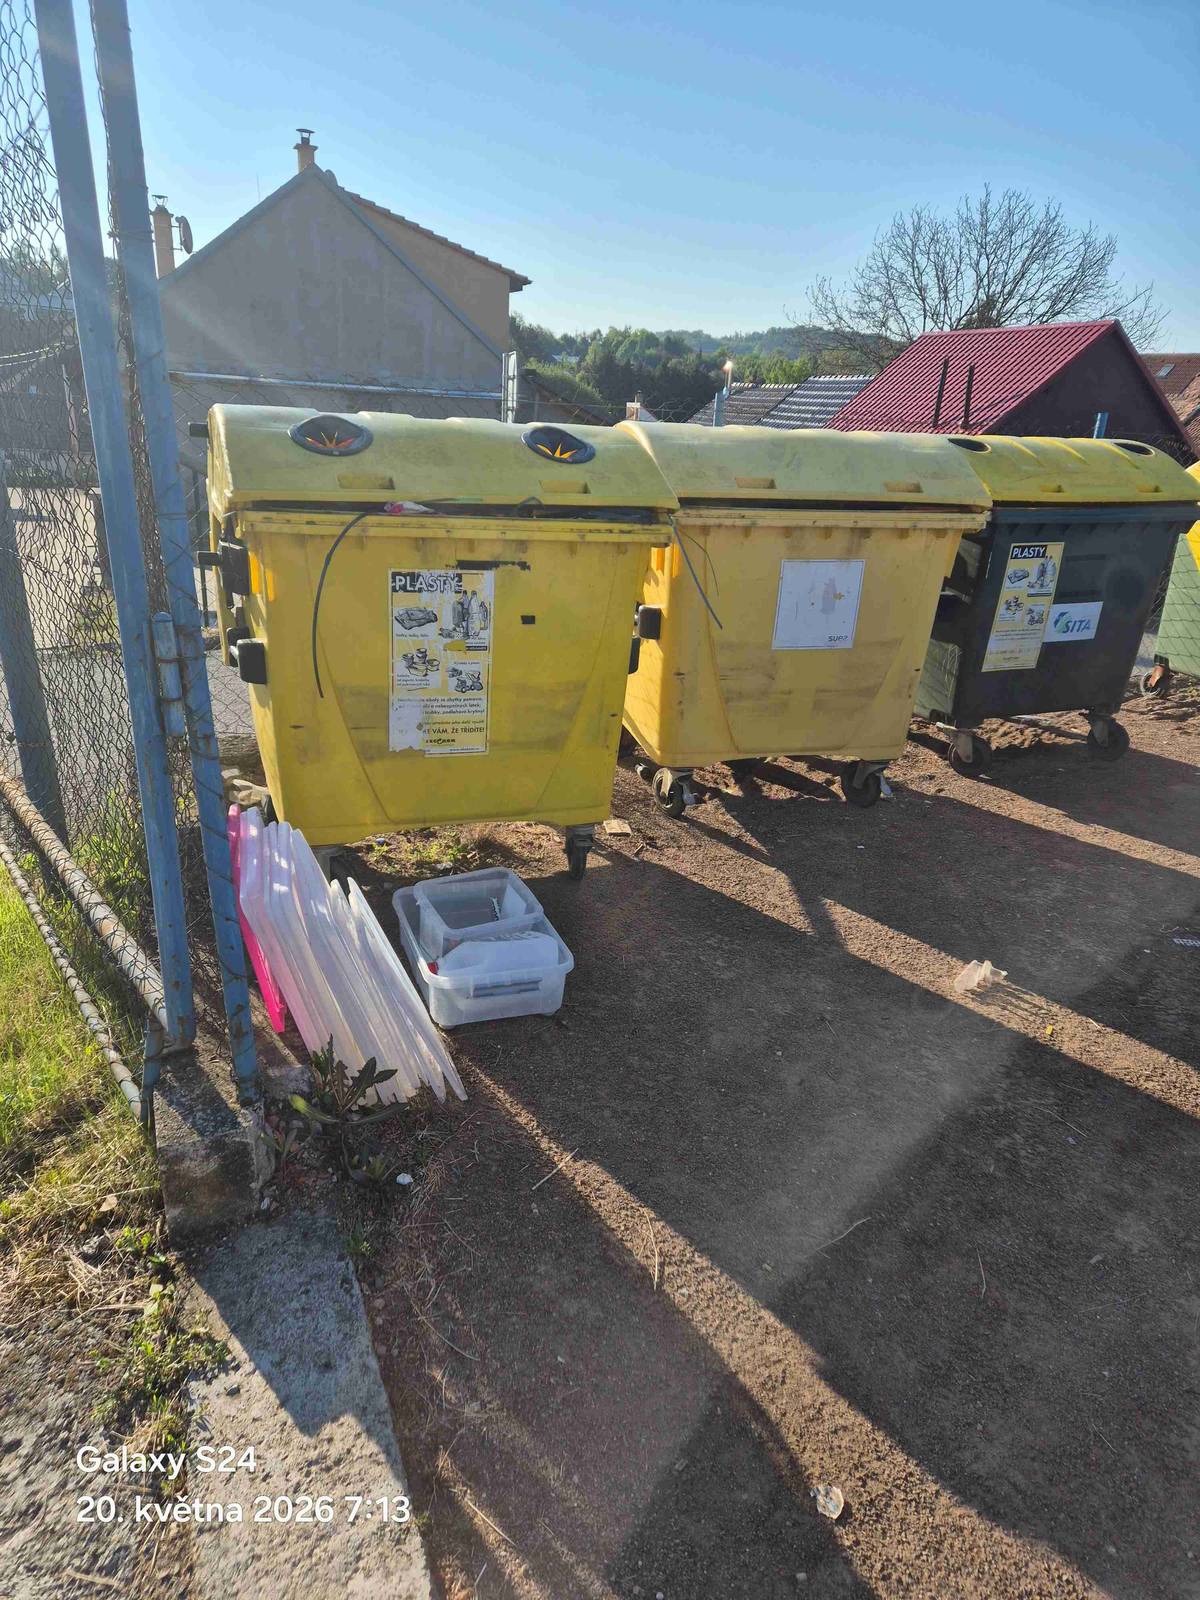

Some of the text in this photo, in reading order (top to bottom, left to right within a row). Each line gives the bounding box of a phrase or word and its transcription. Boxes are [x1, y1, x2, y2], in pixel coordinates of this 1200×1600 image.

[1012, 546, 1046, 558] PLASTY
[395, 575, 460, 592] PLASTY
[1062, 619, 1091, 634] SITA
[451, 726, 459, 734] ŽE
